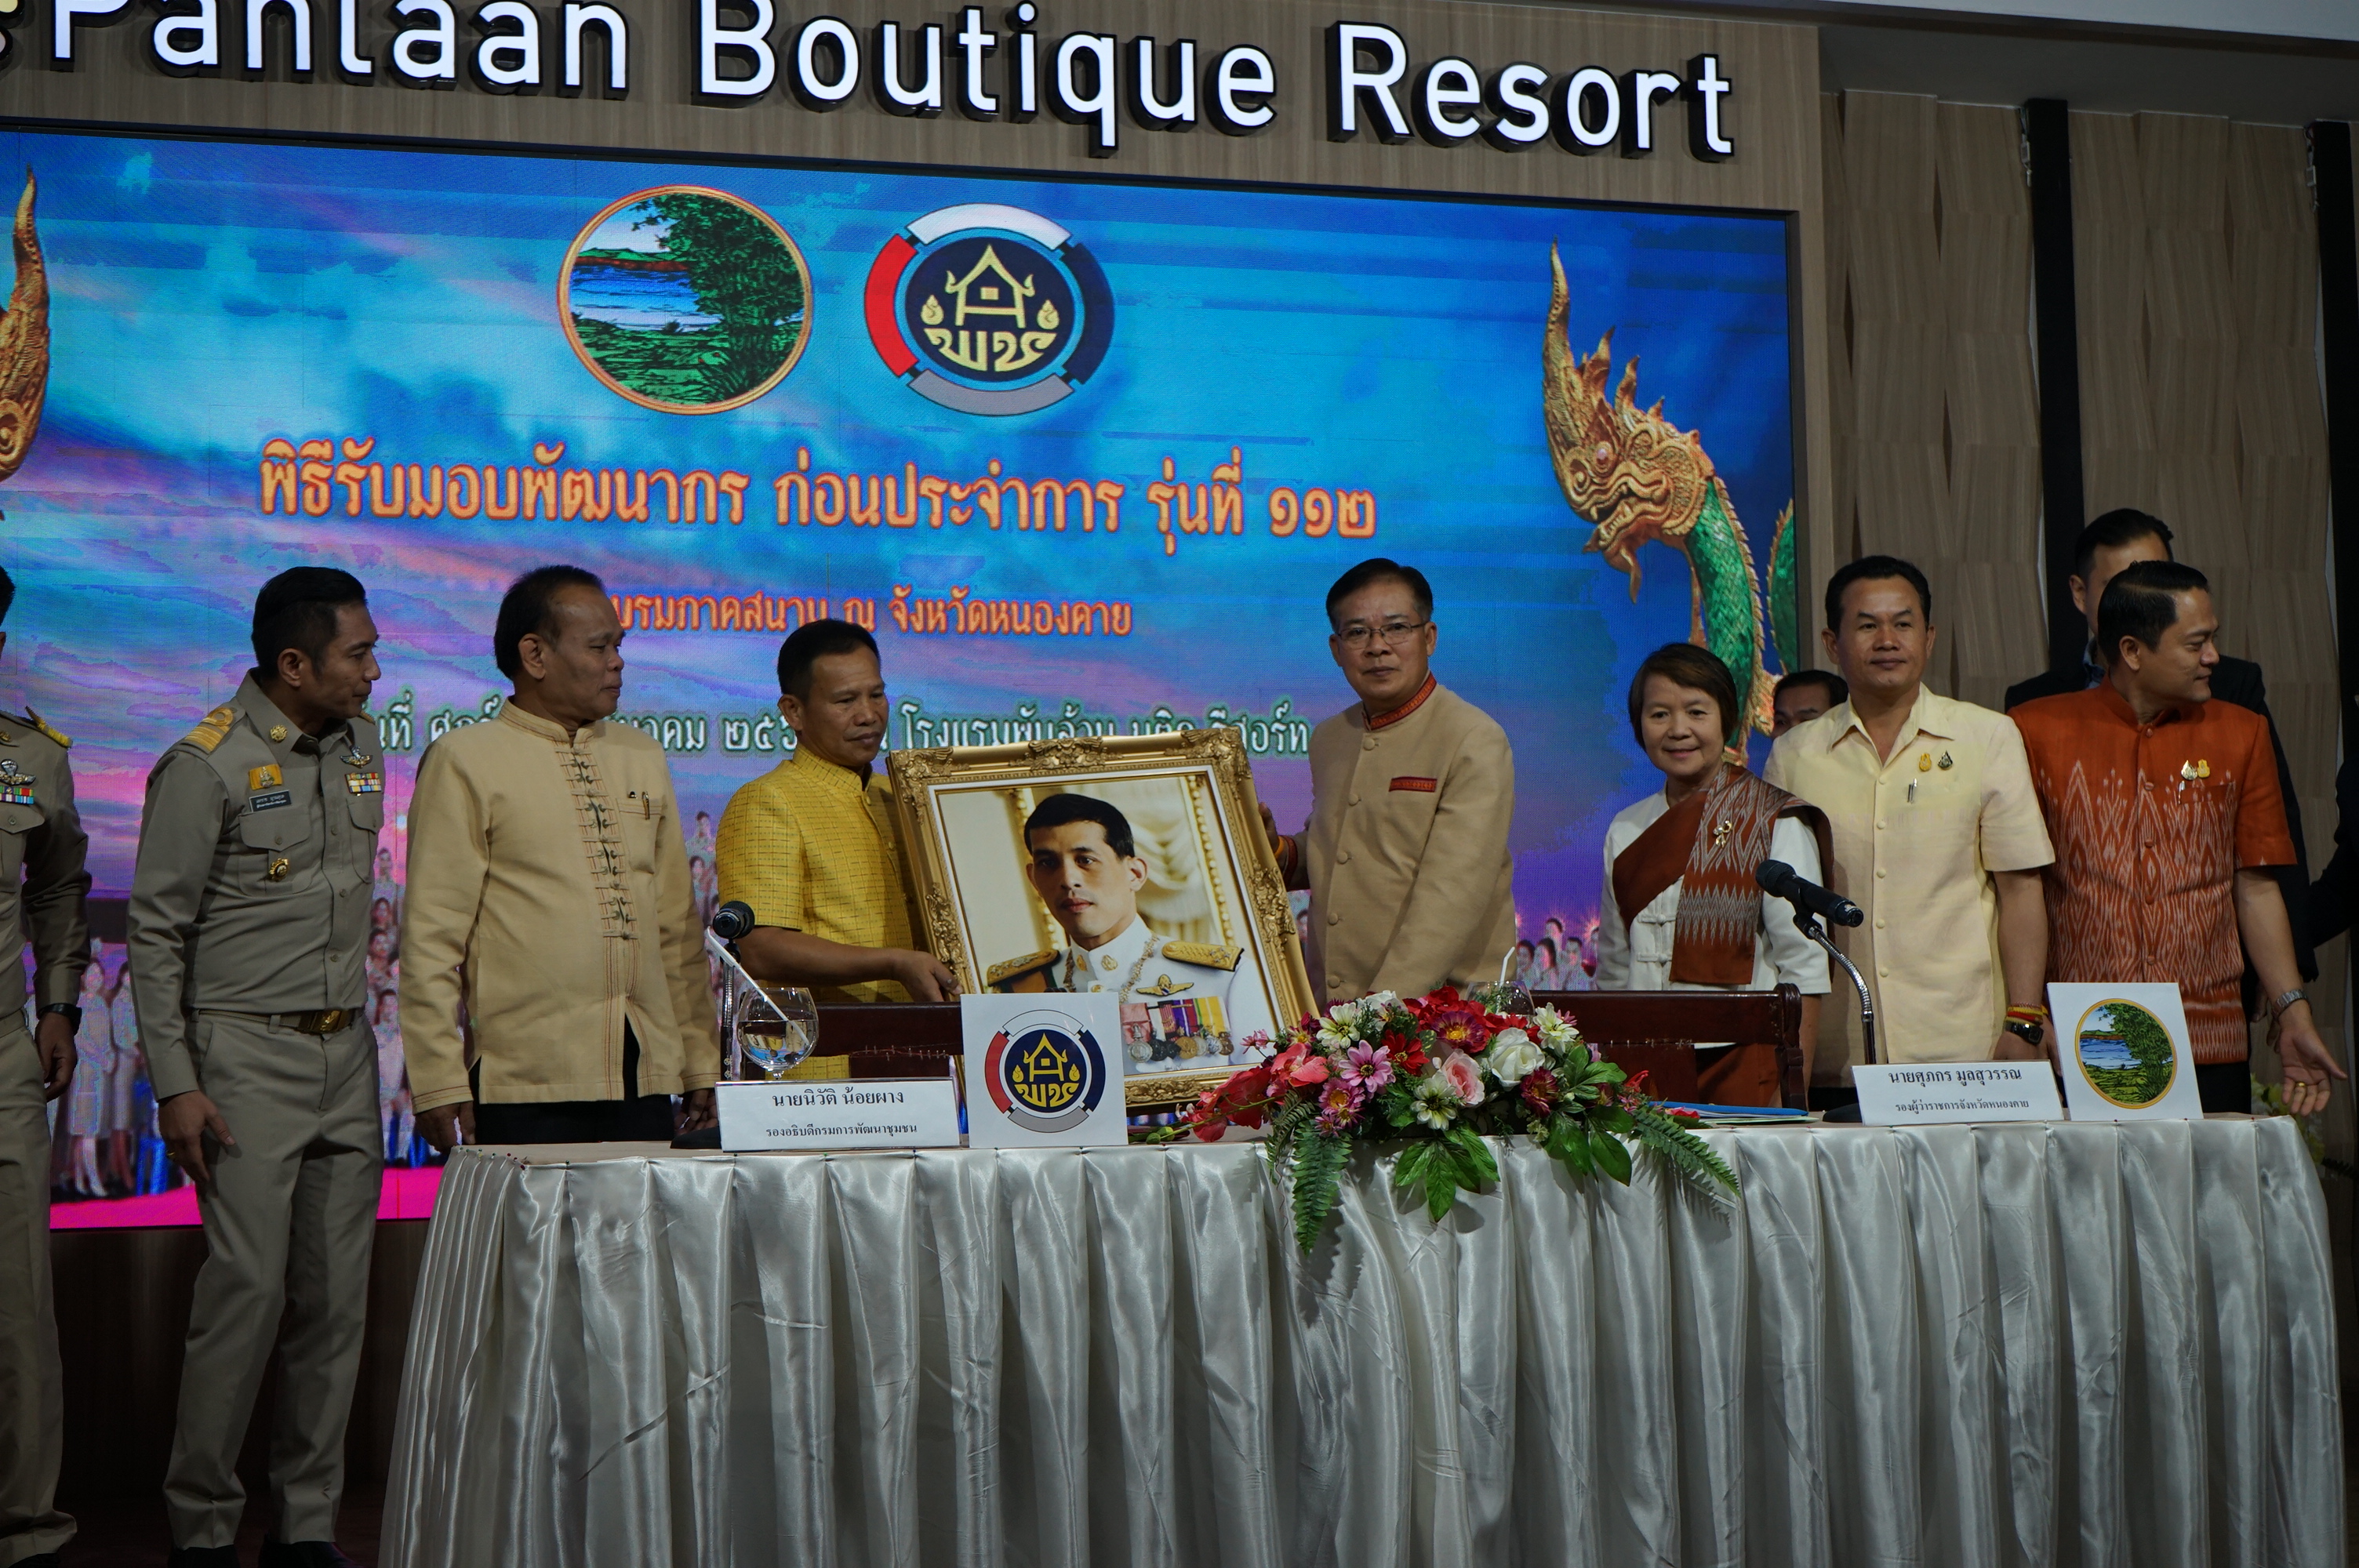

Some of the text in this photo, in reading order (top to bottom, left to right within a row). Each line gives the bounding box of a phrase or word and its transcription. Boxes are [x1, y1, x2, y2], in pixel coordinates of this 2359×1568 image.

[54, 0, 1733, 154] Panlaan Boutique Resort
[260, 437, 1376, 556] พิธีรับมอบพัฒนากร ก่อนประจำการ รุ่นที่ ๑๑๒
[843, 597, 876, 633] ณ
[889, 585, 1132, 636] จังหวัดหนองคาย
[1888, 1067, 2022, 1087] นายศุภกร มูลสุวรรณ
[772, 1086, 904, 1107] นายนิวัติ น้อยผาง
[1895, 1098, 2030, 1115] รองผู้ว่าราชการจังหวัดหนองคาย
[765, 1123, 918, 1138] รองอธิบดีกรมการพัฒนาชุมชน
